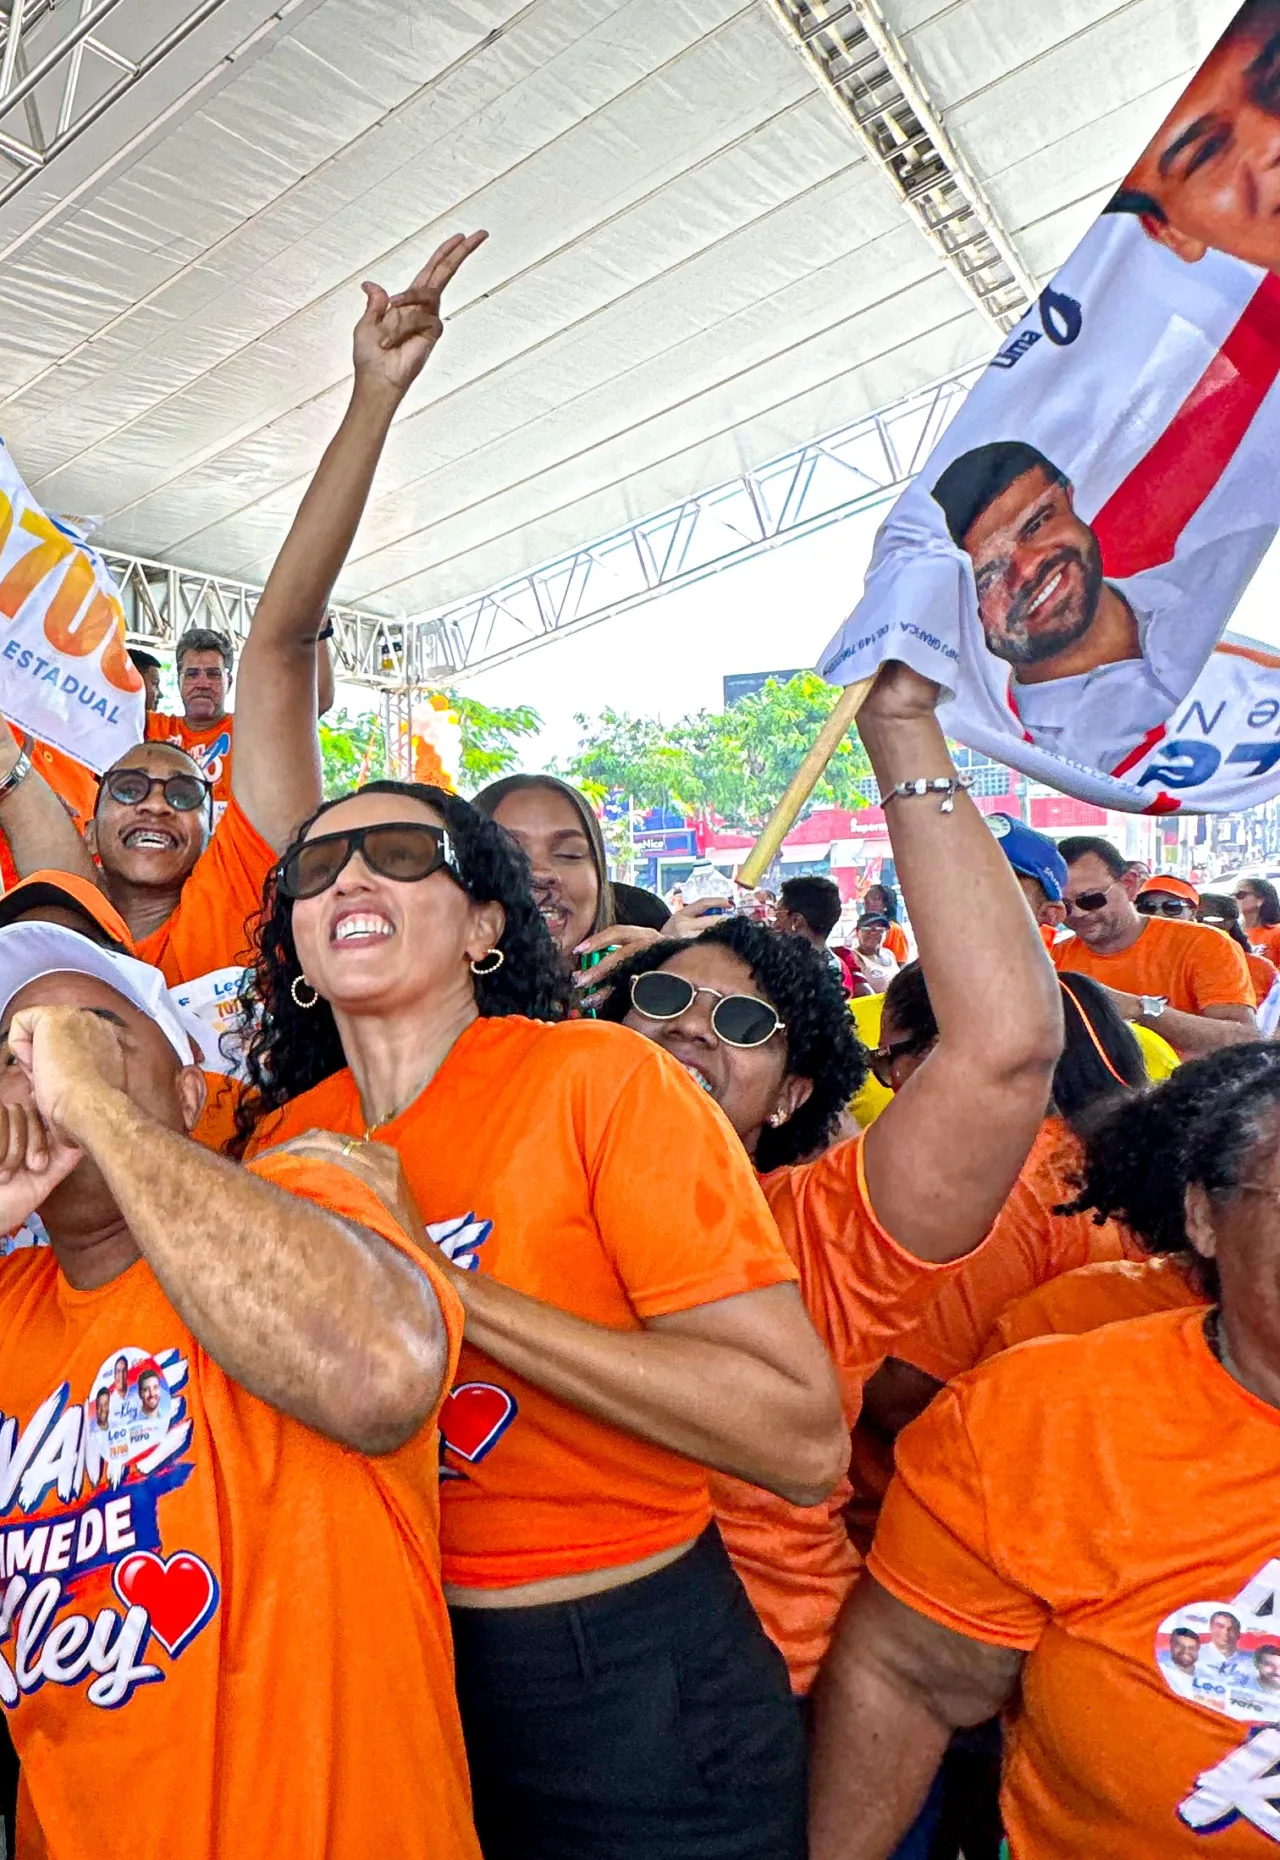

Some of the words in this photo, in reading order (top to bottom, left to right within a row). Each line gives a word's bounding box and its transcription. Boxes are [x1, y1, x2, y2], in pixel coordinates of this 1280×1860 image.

[2, 639, 119, 725] ESTADUAL
[107, 1427, 127, 1441] Leo
[76, 1496, 137, 1563] DE
[1192, 1677, 1226, 1694] Leo
